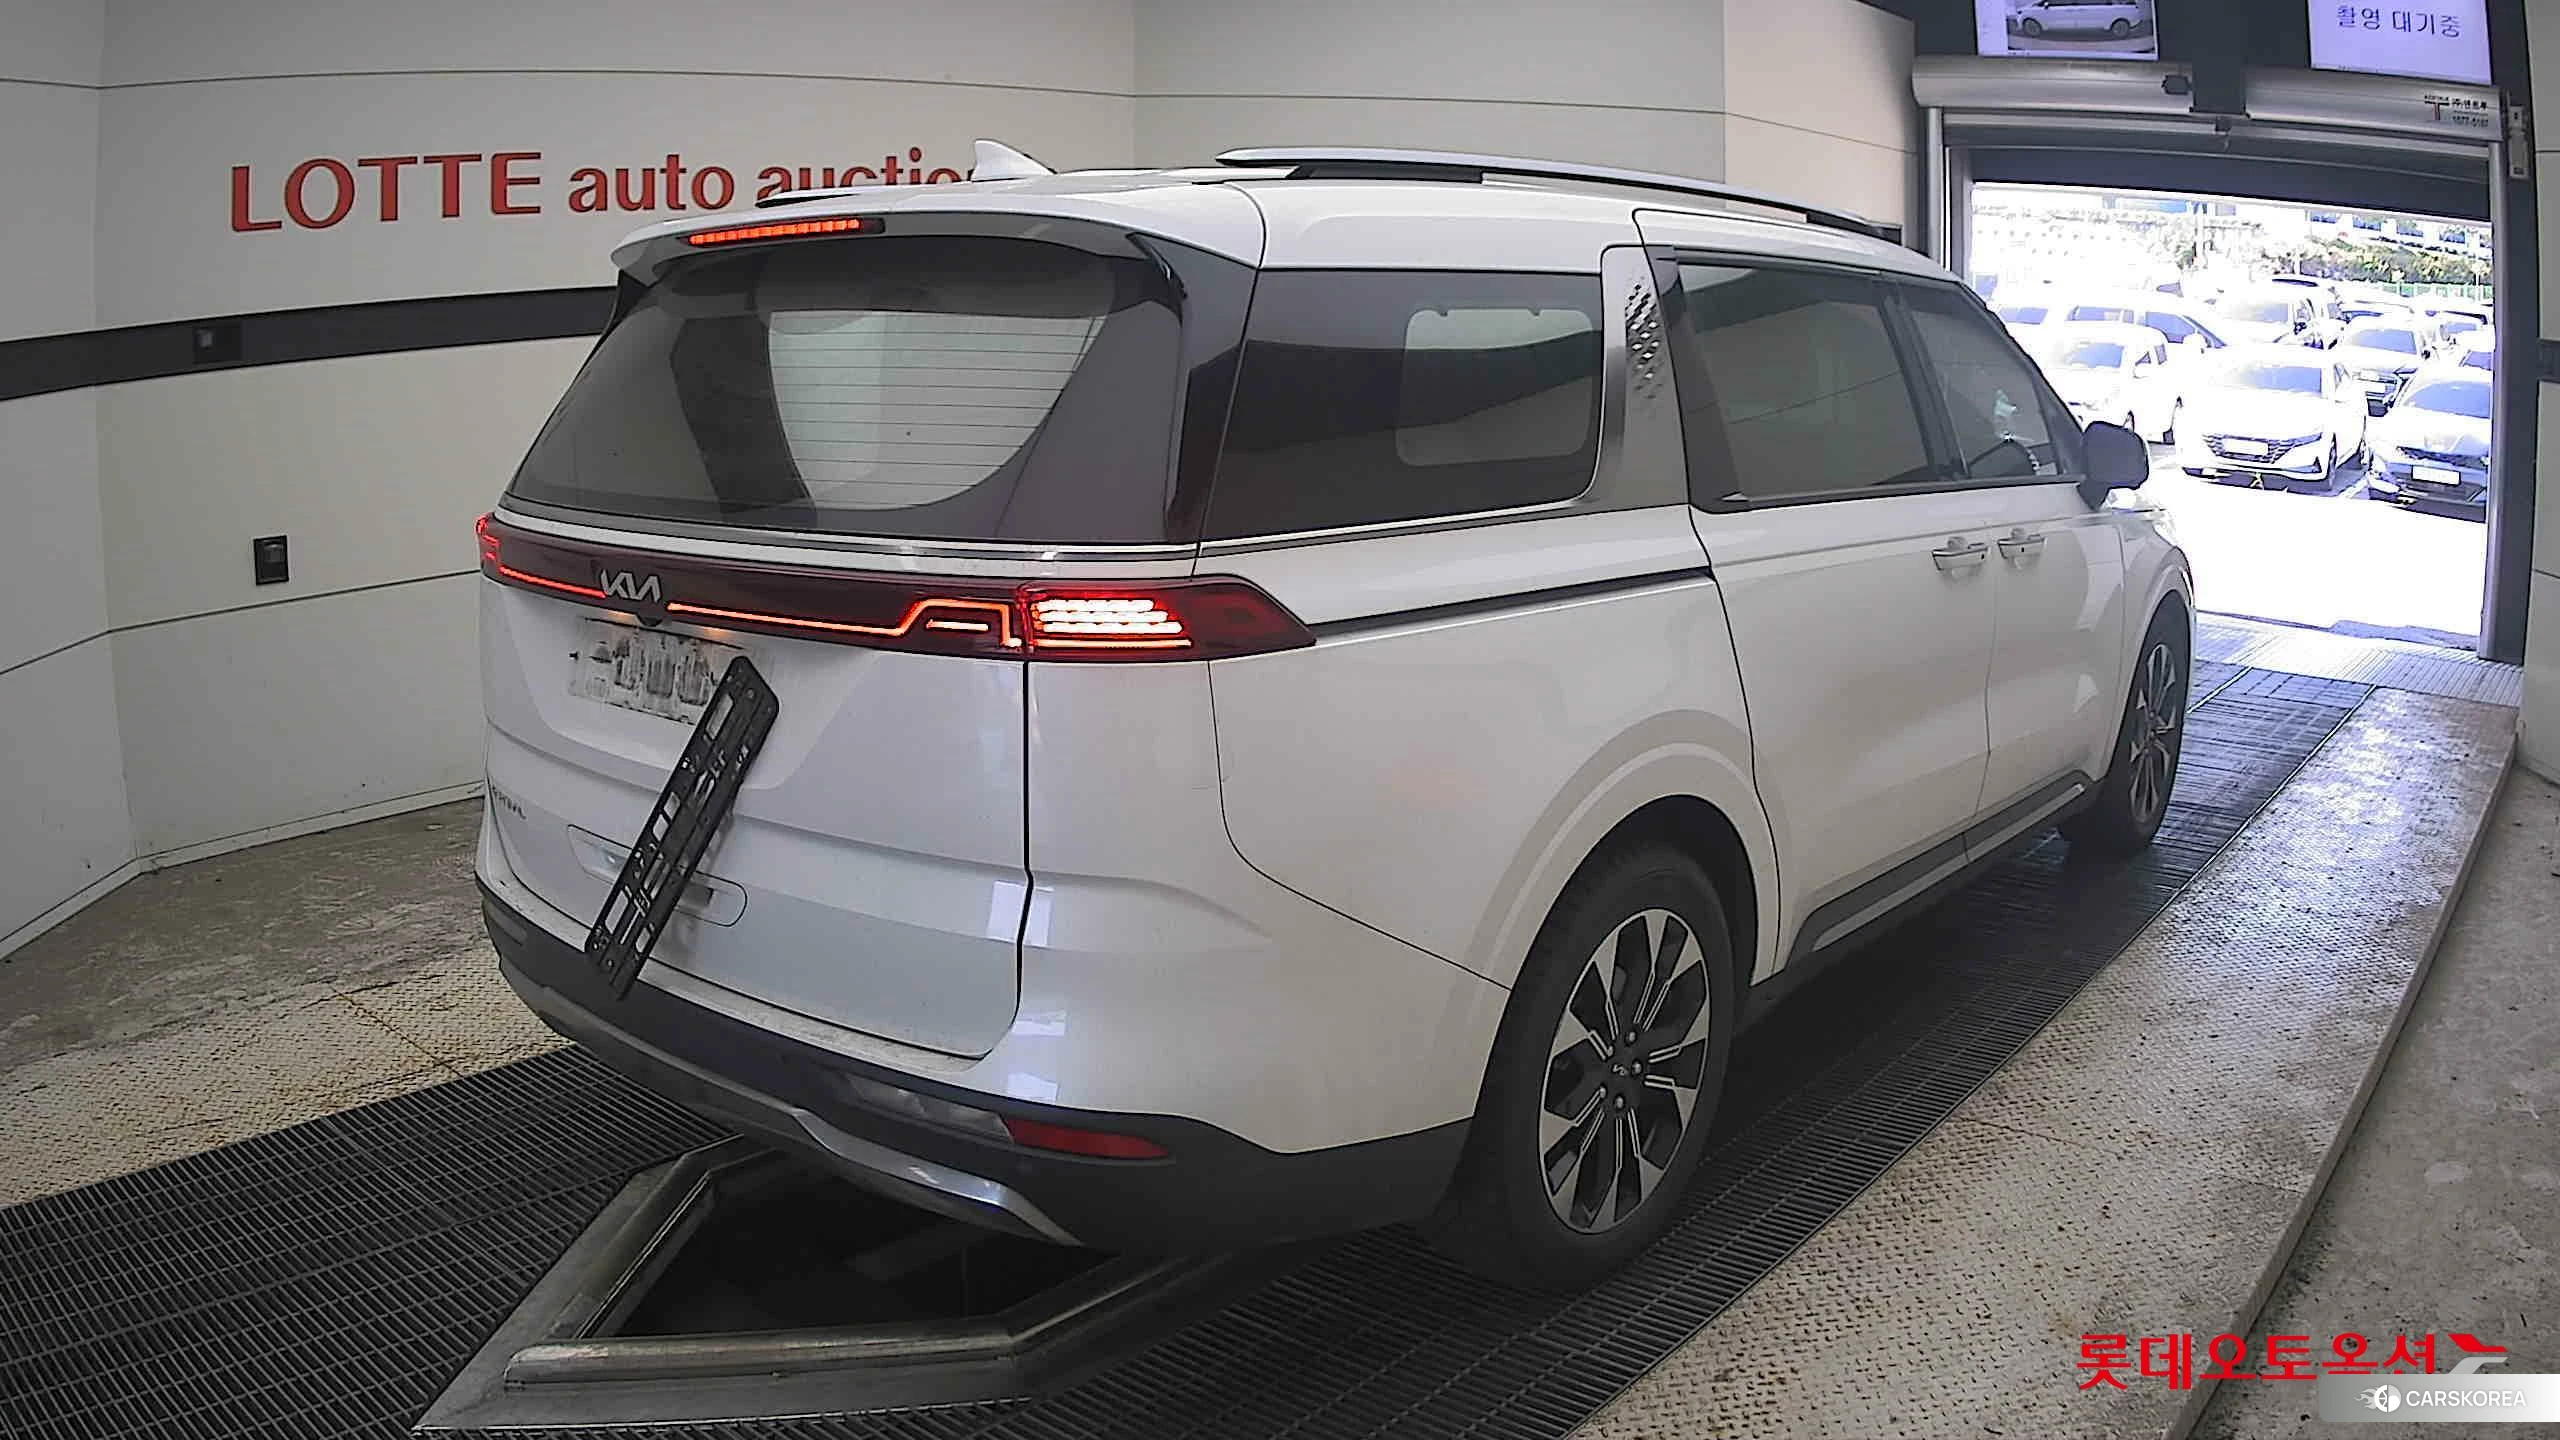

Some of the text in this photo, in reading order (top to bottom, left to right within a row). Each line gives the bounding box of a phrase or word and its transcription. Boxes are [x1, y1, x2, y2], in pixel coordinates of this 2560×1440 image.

[2391, 10, 2460, 38] 대기중
[231, 146, 975, 232] LOTTE auto aucti
[600, 569, 662, 603] KIA
